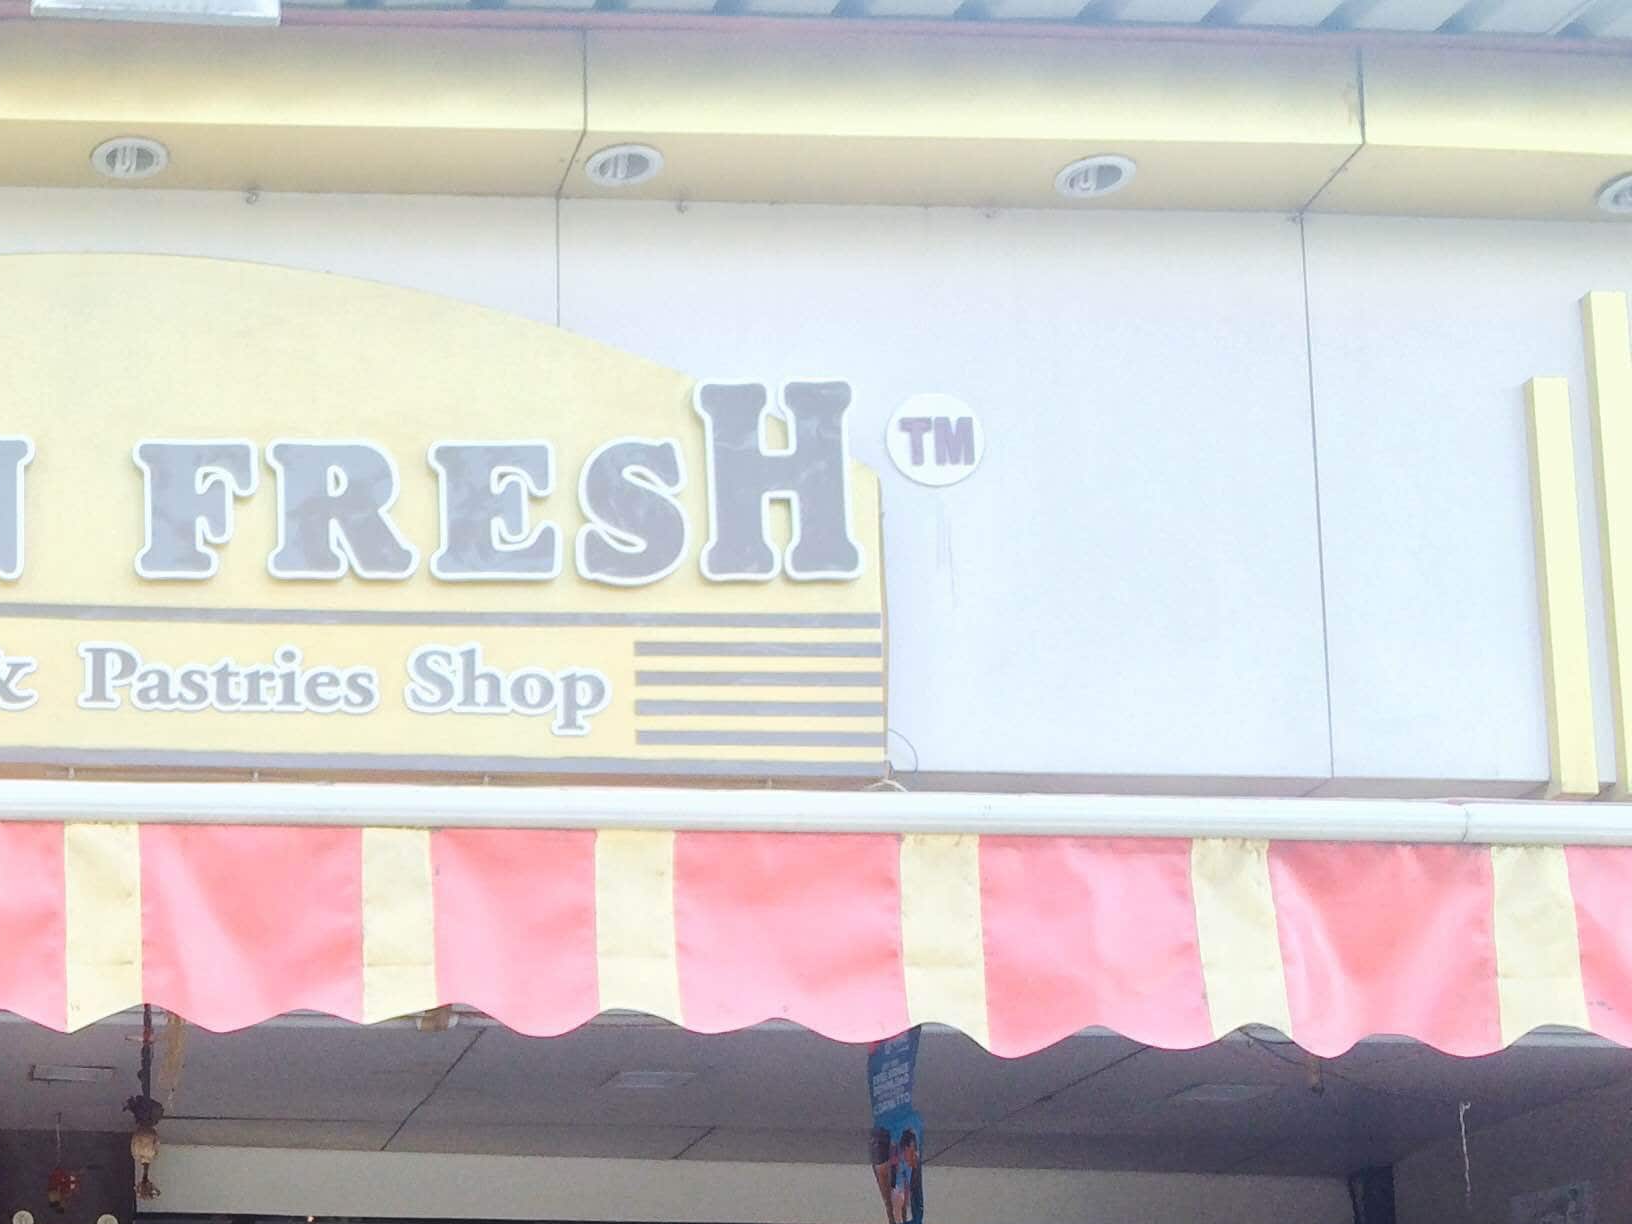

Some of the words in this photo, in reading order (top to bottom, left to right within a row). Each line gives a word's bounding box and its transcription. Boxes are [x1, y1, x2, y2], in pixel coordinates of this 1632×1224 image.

[132, 377, 866, 586] FRESH
[899, 416, 975, 467] TM
[81, 646, 378, 709] Pastries
[408, 645, 608, 733] Shop
